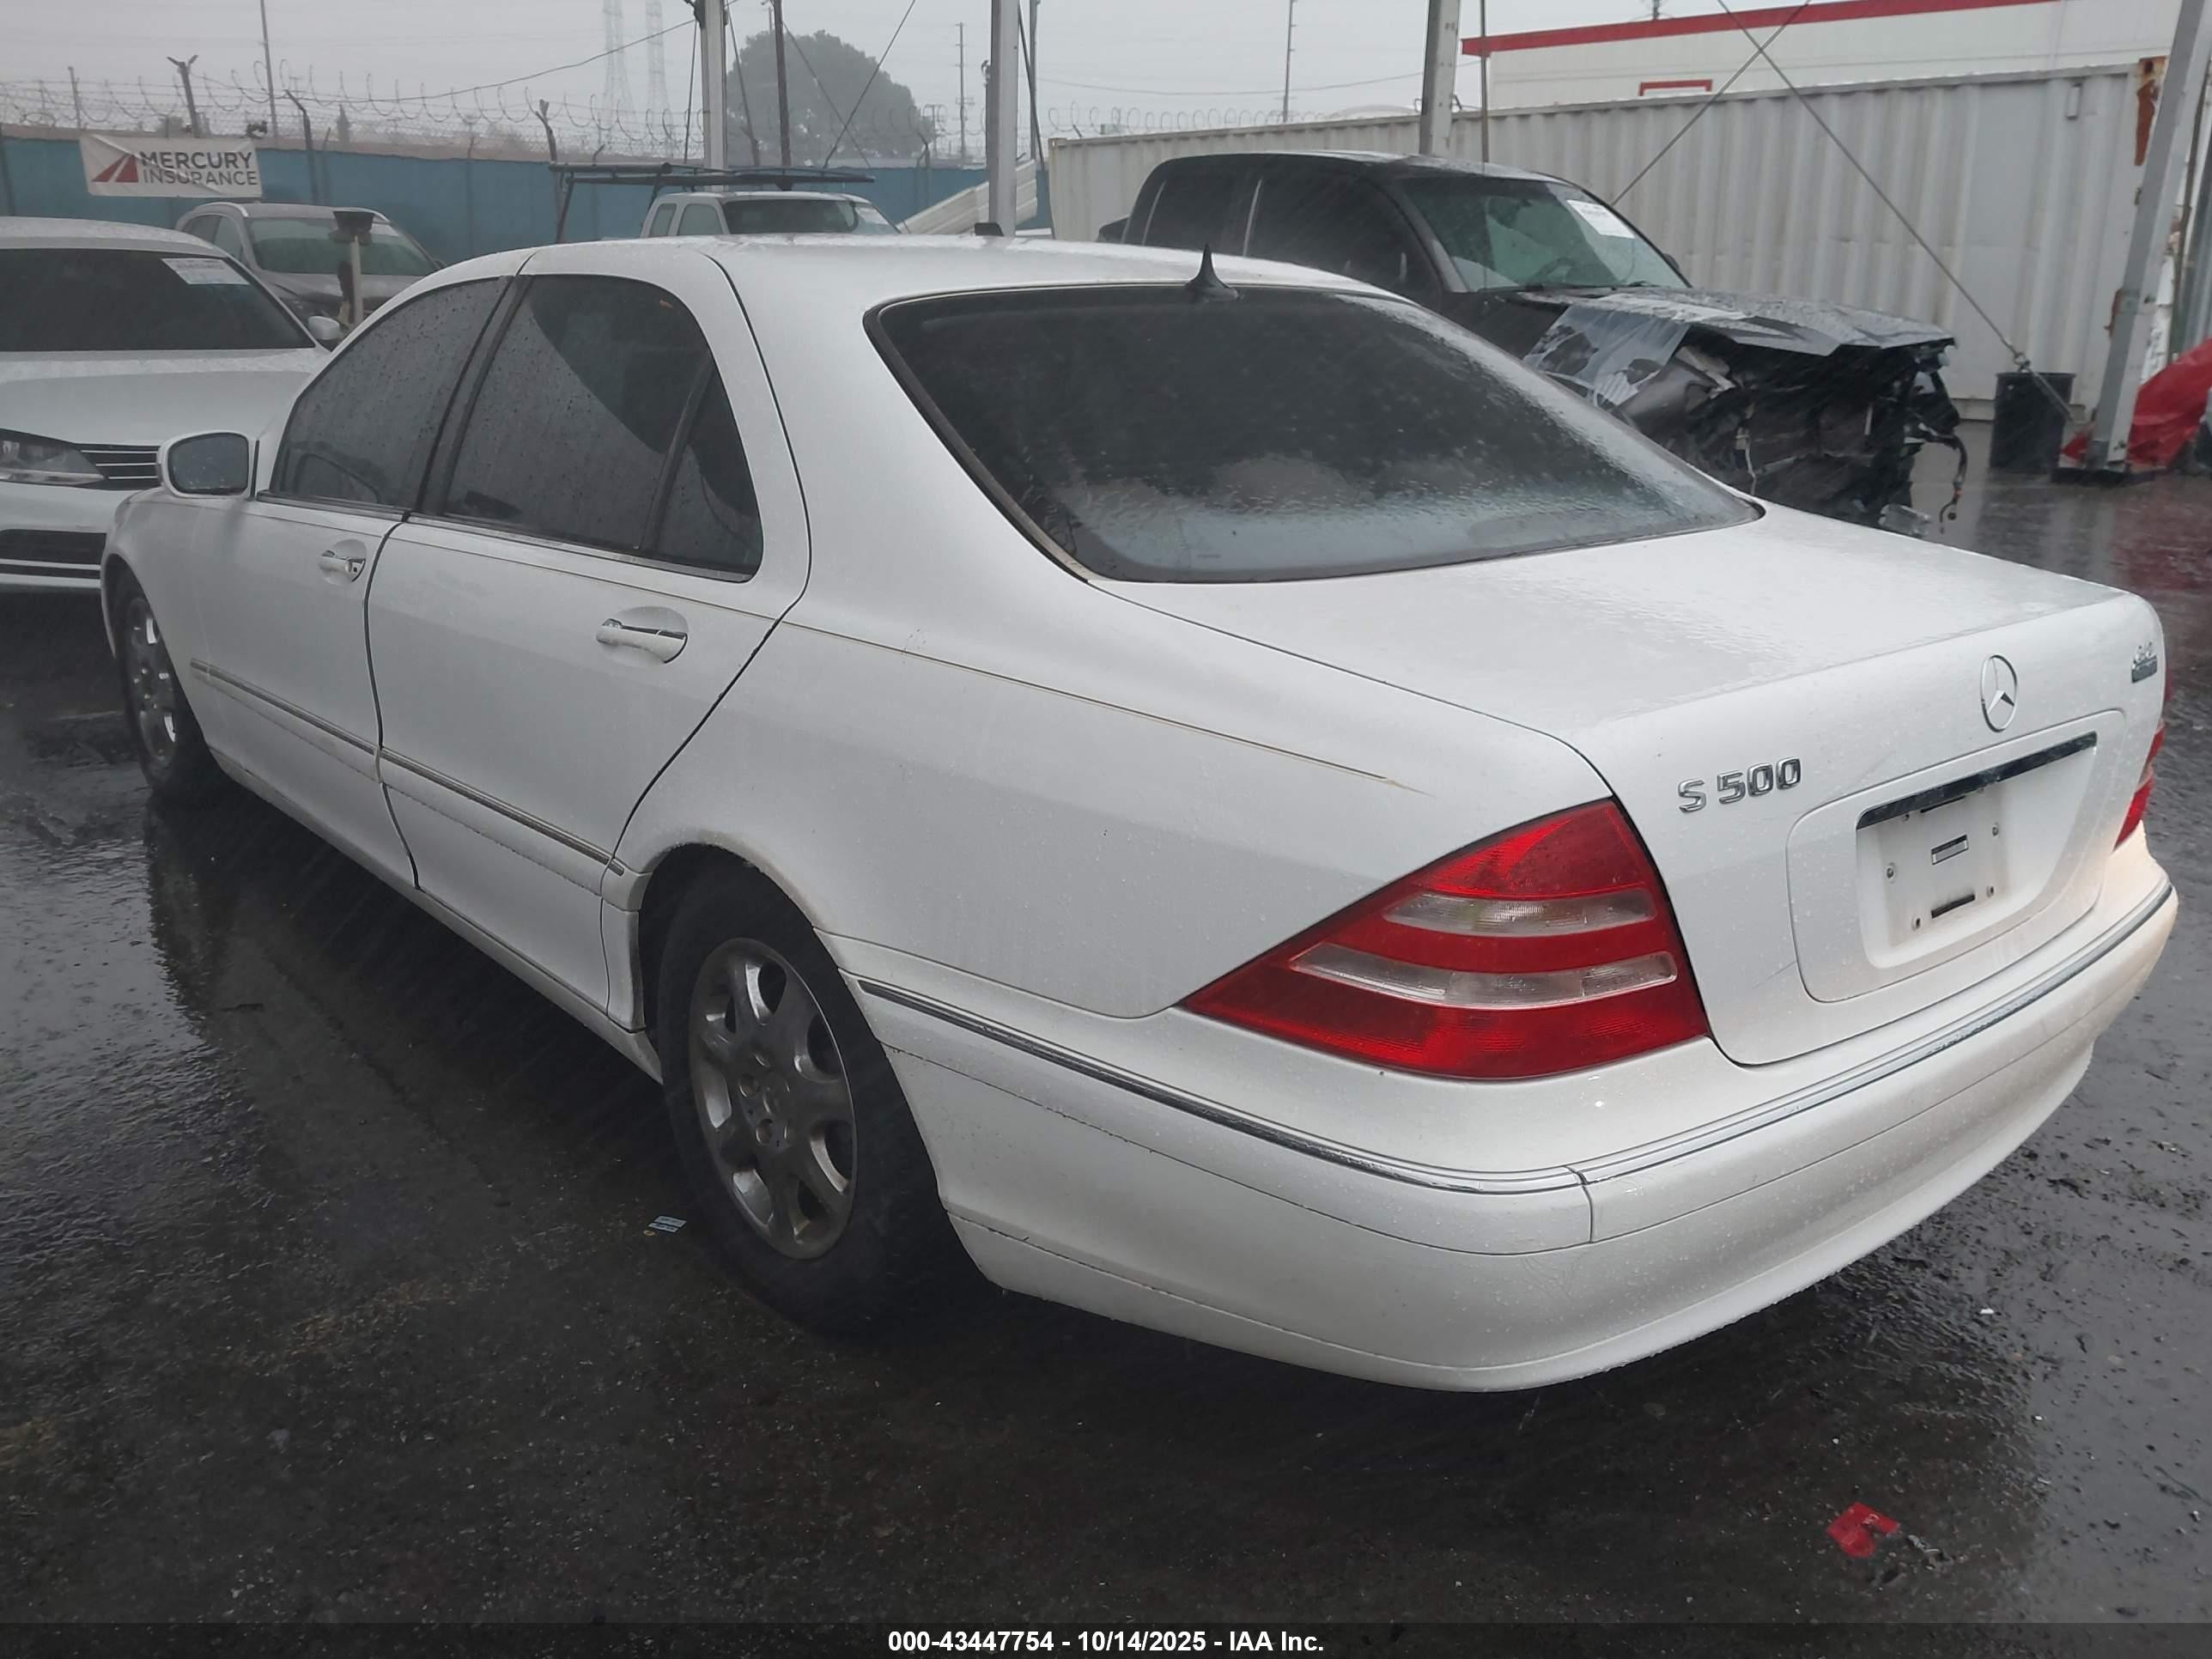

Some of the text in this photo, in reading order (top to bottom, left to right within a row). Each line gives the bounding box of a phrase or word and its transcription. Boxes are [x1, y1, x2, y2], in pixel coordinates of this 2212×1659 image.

[139, 151, 252, 170] MERCURY
[143, 170, 258, 186] INSURANCE
[1678, 757, 1802, 813] S 500
